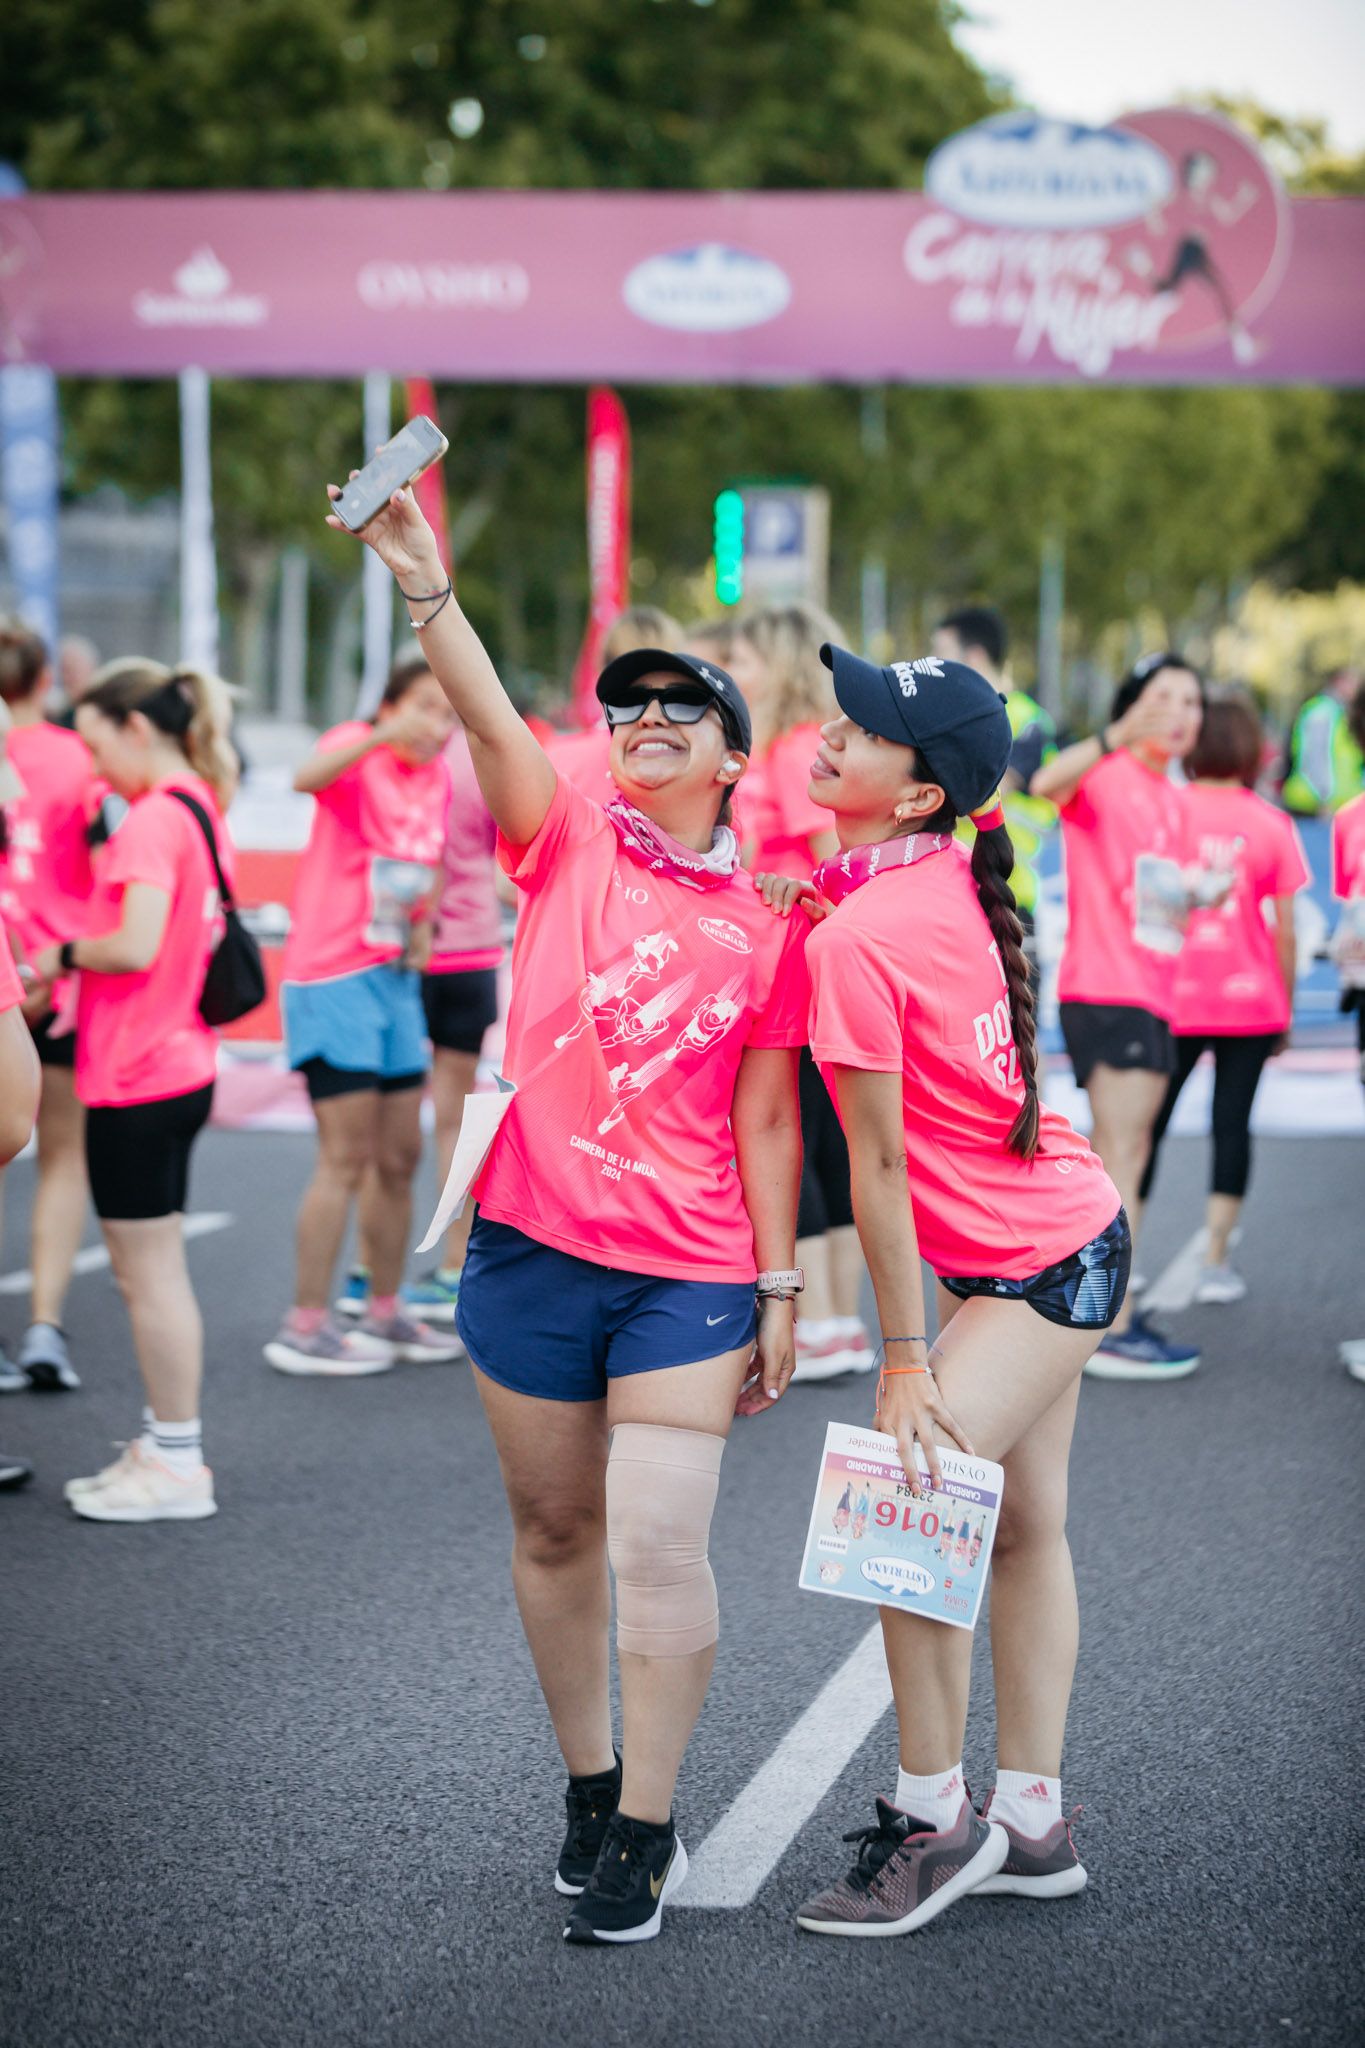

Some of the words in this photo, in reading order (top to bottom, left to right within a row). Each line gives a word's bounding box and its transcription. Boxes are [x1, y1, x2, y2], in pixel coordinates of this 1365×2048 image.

[988, 938, 1009, 986] T
[973, 992, 1012, 1060] DO
[570, 1135, 606, 1161] CARRERA
[606, 1151, 619, 1166] DE
[619, 1157, 631, 1171] LA
[632, 1161, 661, 1180] MUJE
[601, 1163, 622, 1183] 2024
[847, 1459, 882, 1476] MADRID
[945, 1482, 981, 1502] CARRERA
[875, 1501, 940, 1538] 016
[866, 1560, 931, 1590] ASTURIANA
